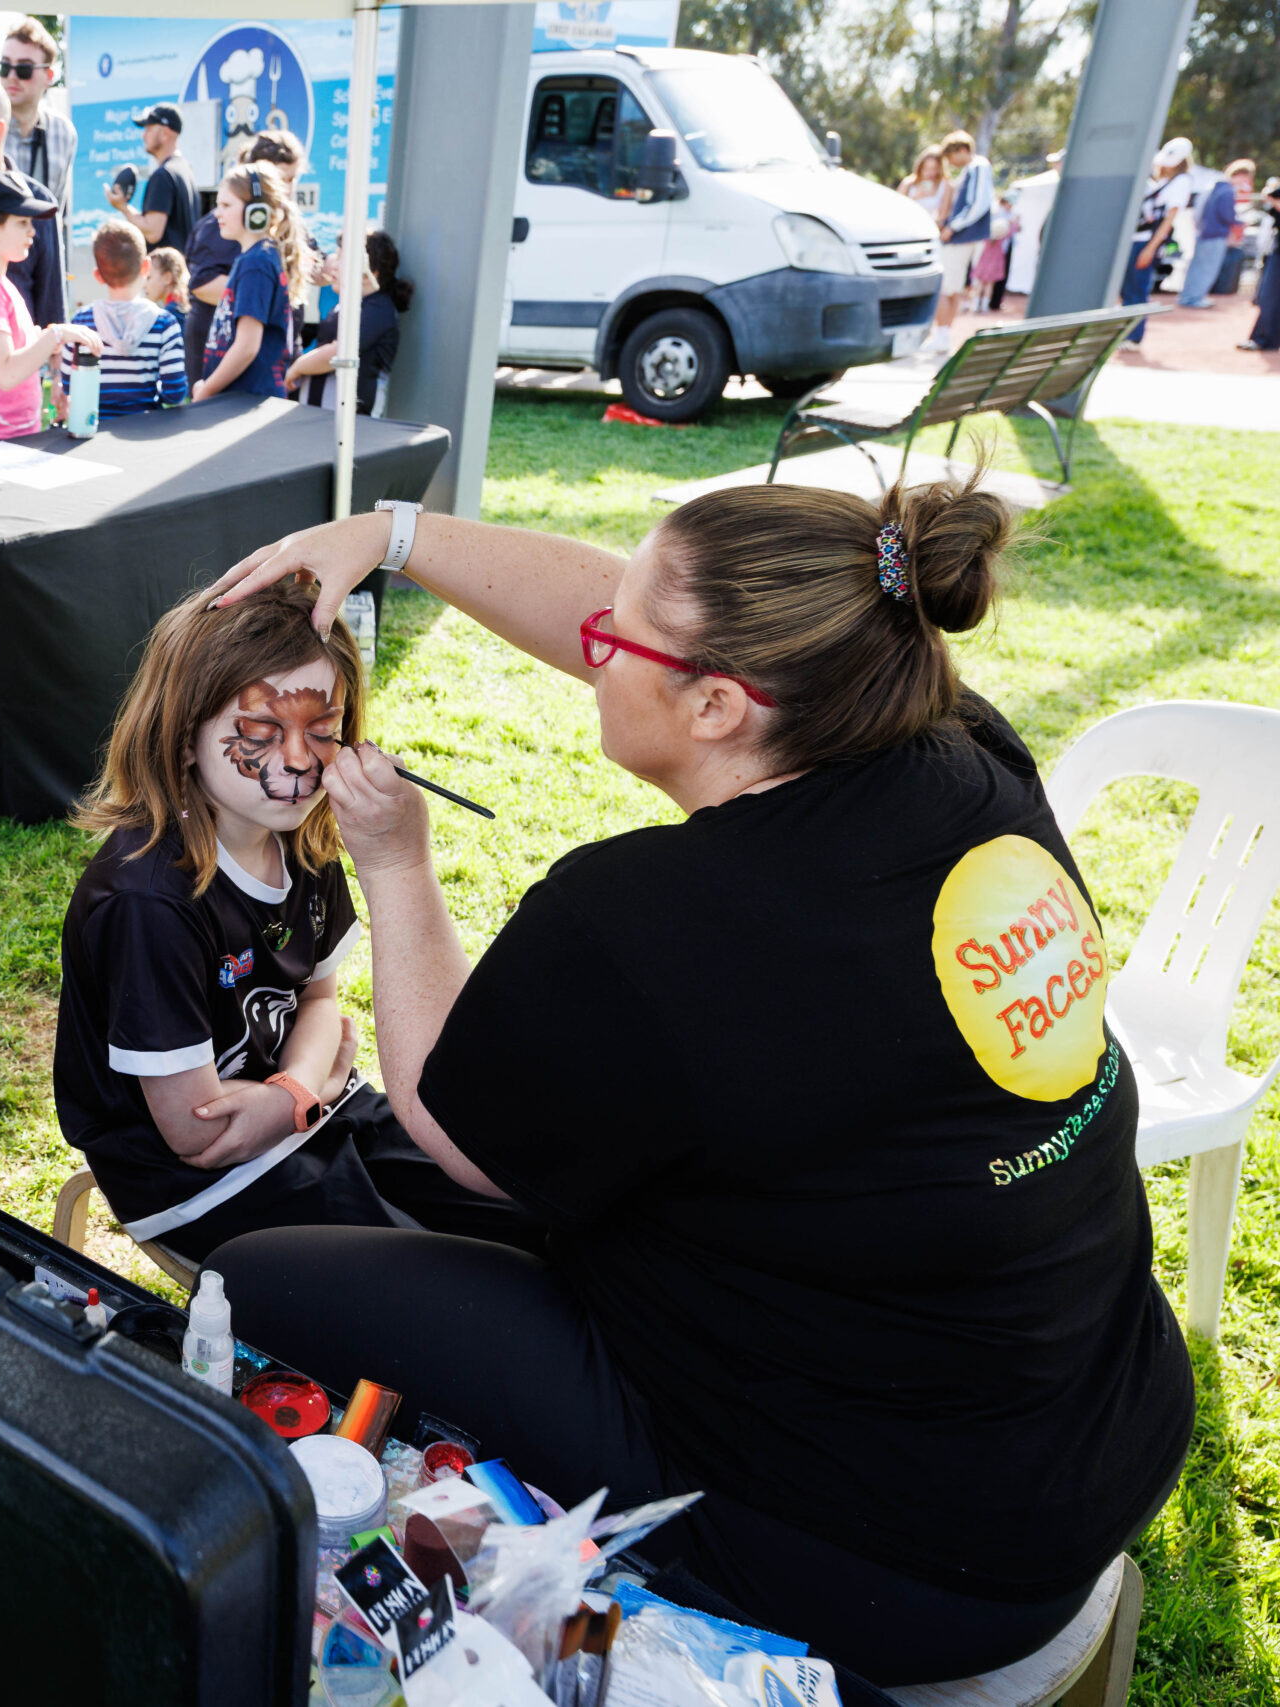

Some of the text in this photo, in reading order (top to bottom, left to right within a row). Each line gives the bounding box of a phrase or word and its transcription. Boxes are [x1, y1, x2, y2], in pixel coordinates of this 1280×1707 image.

[240, 951, 253, 962] AFL
[954, 876, 1080, 994] Sunny
[995, 929, 1105, 1060] Faces
